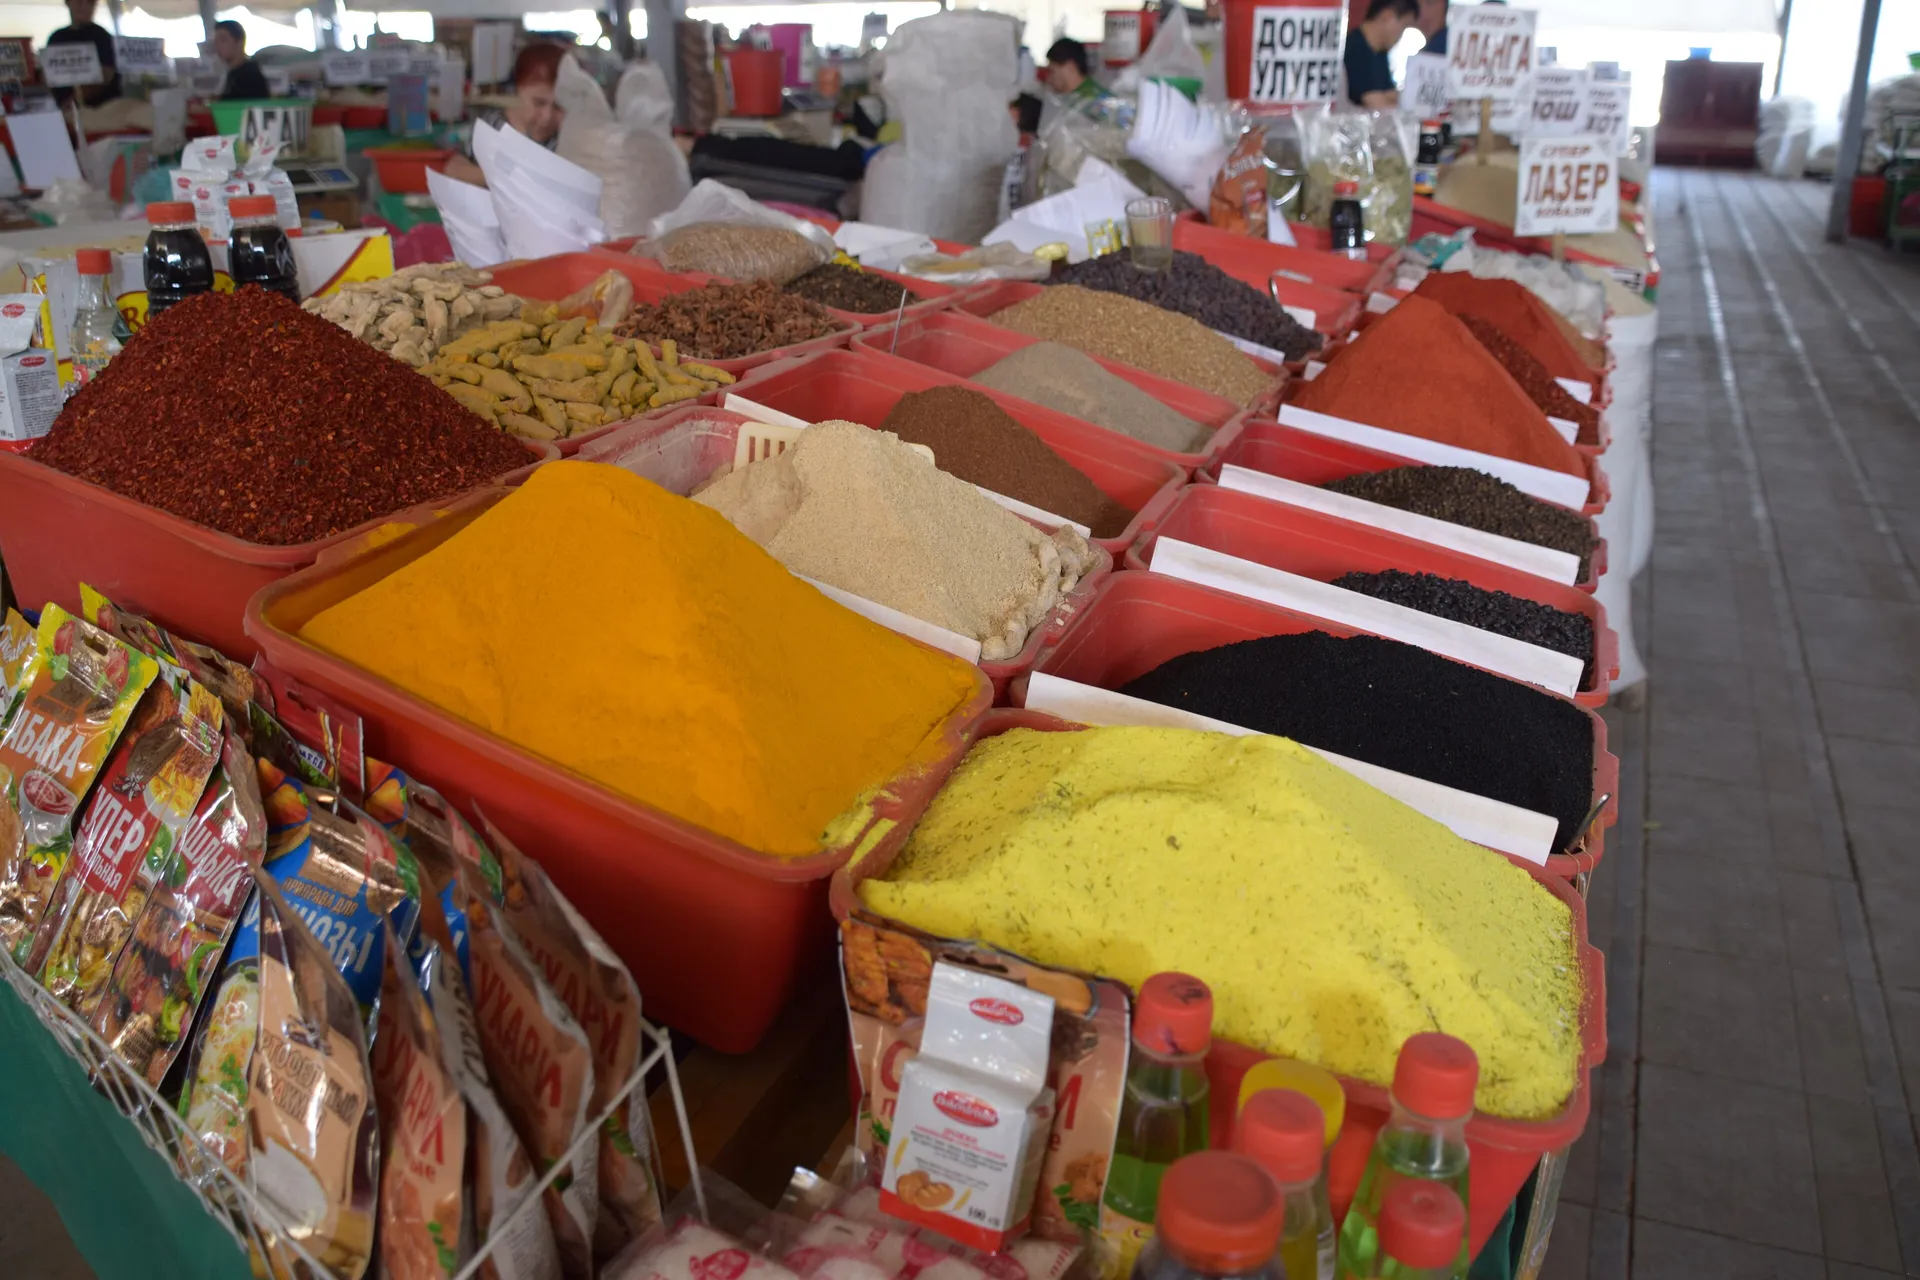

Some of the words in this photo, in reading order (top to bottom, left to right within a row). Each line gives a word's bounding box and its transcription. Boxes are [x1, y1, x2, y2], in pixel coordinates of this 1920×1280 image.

[1523, 162, 1609, 205] ЛАЗЕР
[81, 784, 146, 866] УПЕР
[281, 876, 336, 909] ПРИПРАВА
[331, 896, 359, 917] ДЛЯ
[473, 951, 562, 1109] УХАРИ
